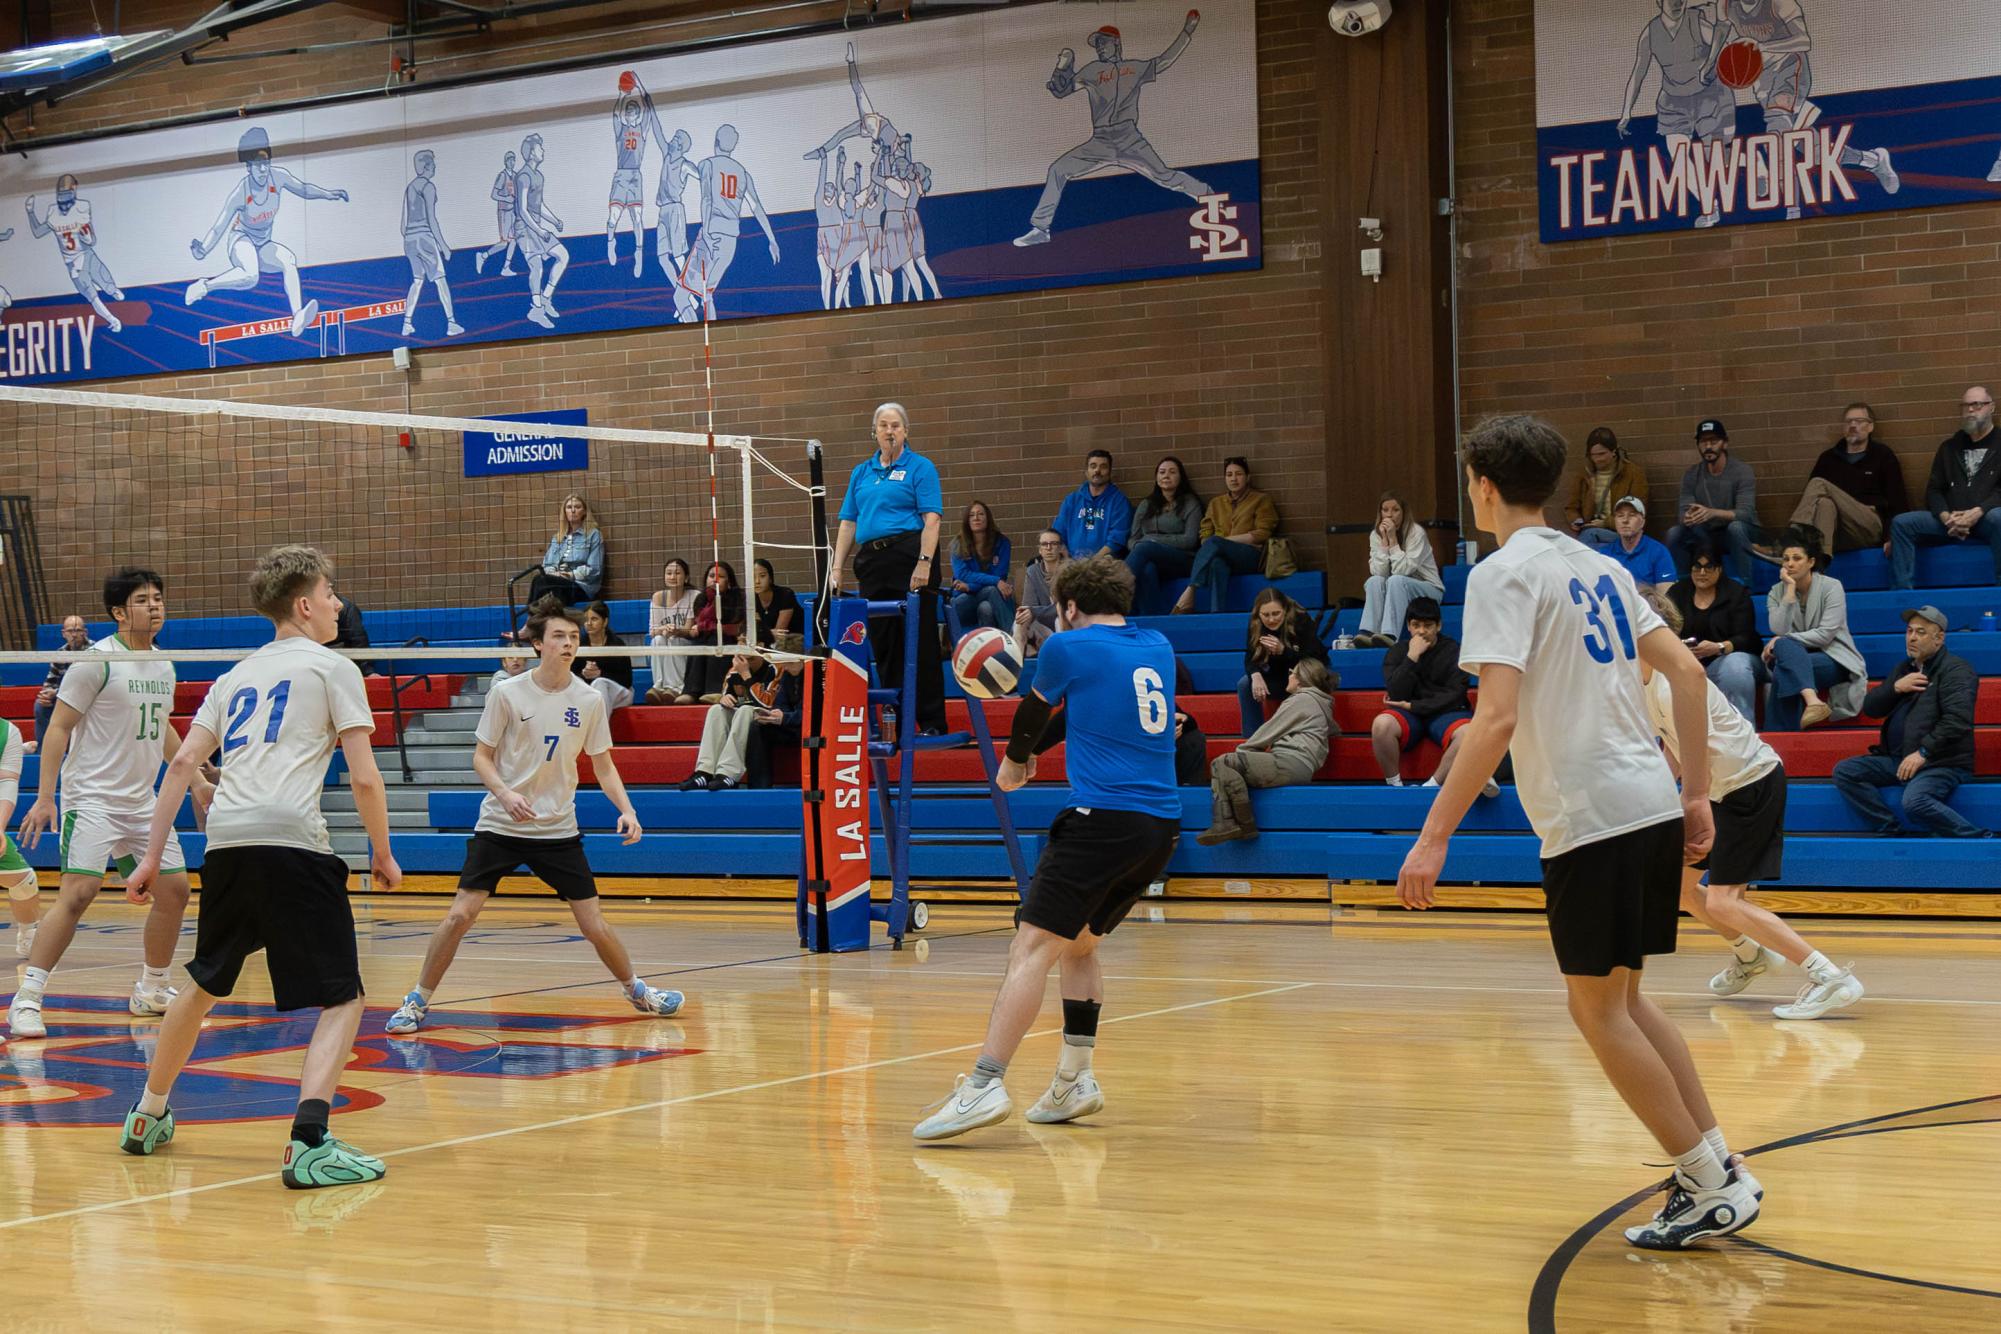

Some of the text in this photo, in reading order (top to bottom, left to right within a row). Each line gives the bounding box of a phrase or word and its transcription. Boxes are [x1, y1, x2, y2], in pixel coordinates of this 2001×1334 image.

[719, 171, 738, 200] 10
[1550, 123, 1857, 229] TEAMWORK
[63, 231, 76, 251] 3
[368, 301, 407, 317] LA SAL
[242, 325, 257, 337] LA
[487, 443, 563, 465] ADMISSION
[1568, 573, 1637, 664] 31
[128, 680, 171, 695] REYNOLDS
[1132, 666, 1168, 734] 6
[136, 702, 162, 741] 15
[223, 680, 292, 754] 21
[543, 735, 560, 762] 7
[834, 705, 867, 861] LA SALLE
